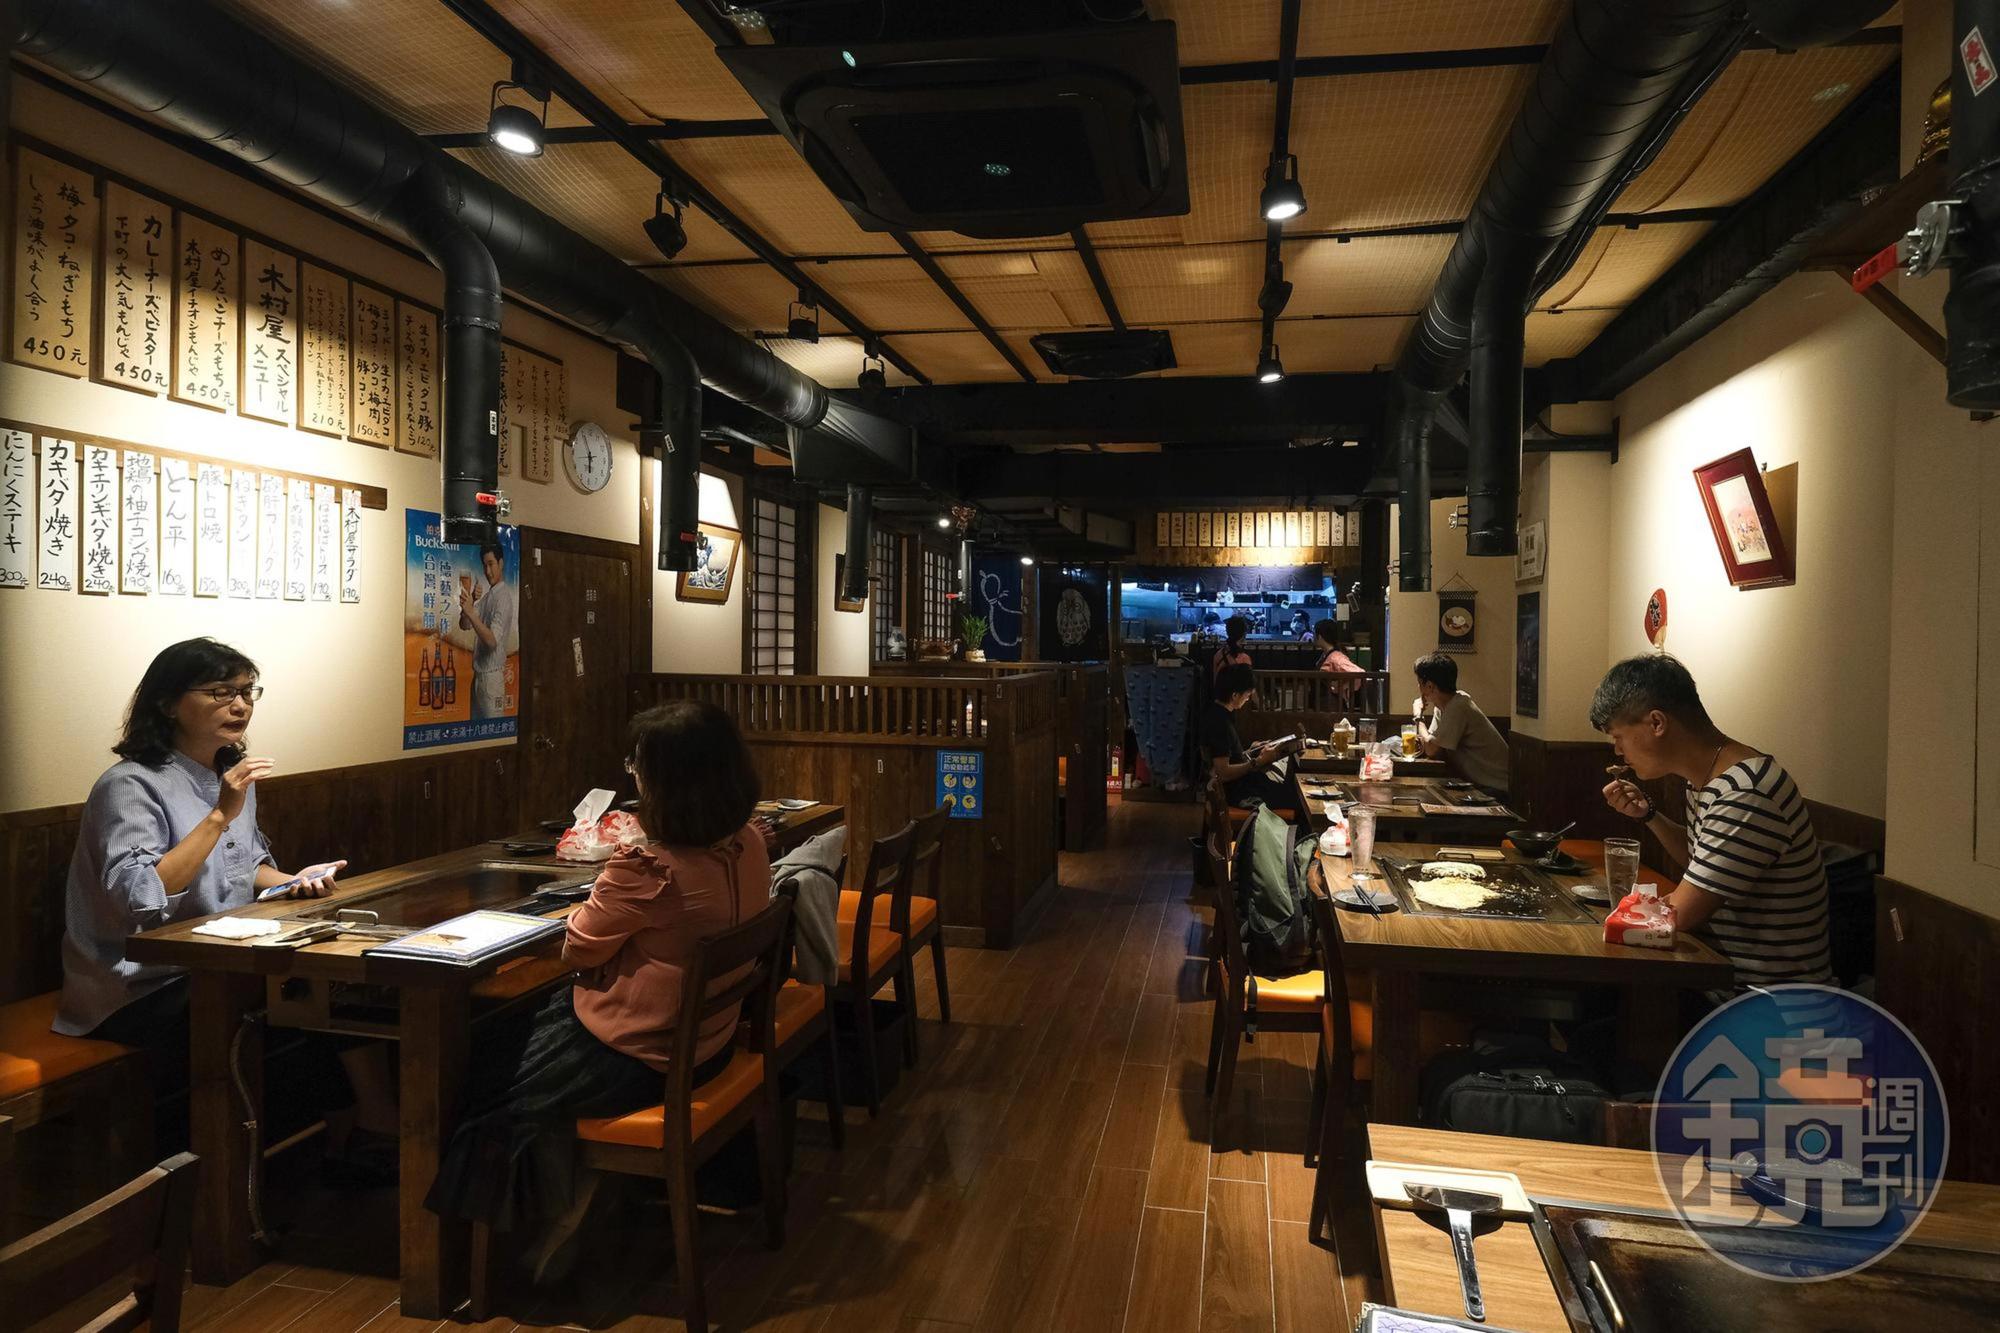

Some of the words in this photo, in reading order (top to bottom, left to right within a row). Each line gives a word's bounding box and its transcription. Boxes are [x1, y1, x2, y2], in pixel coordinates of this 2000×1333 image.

[256, 263, 293, 345] 木村屋
[24, 336, 87, 366] 450元
[114, 361, 168, 387] 450元
[253, 344, 269, 402] メニュー
[275, 348, 291, 413] スペシャル
[186, 382, 234, 406] 450元
[312, 413, 345, 431] 210元
[357, 423, 381, 439] 150元
[3, 434, 25, 553] にんにくステーキ
[44, 441, 73, 557] カキバター焼き
[164, 467, 187, 549] とん平
[200, 470, 223, 544] 豚トロ焼
[88, 448, 113, 578] カキエリンギバター焼き
[344, 507, 361, 582] 木村屋サラダ
[0, 568, 30, 586] 300元
[40, 572, 72, 591] 240元
[85, 579, 115, 593] 240元
[124, 577, 152, 593] 190元
[162, 569, 187, 594] 160元
